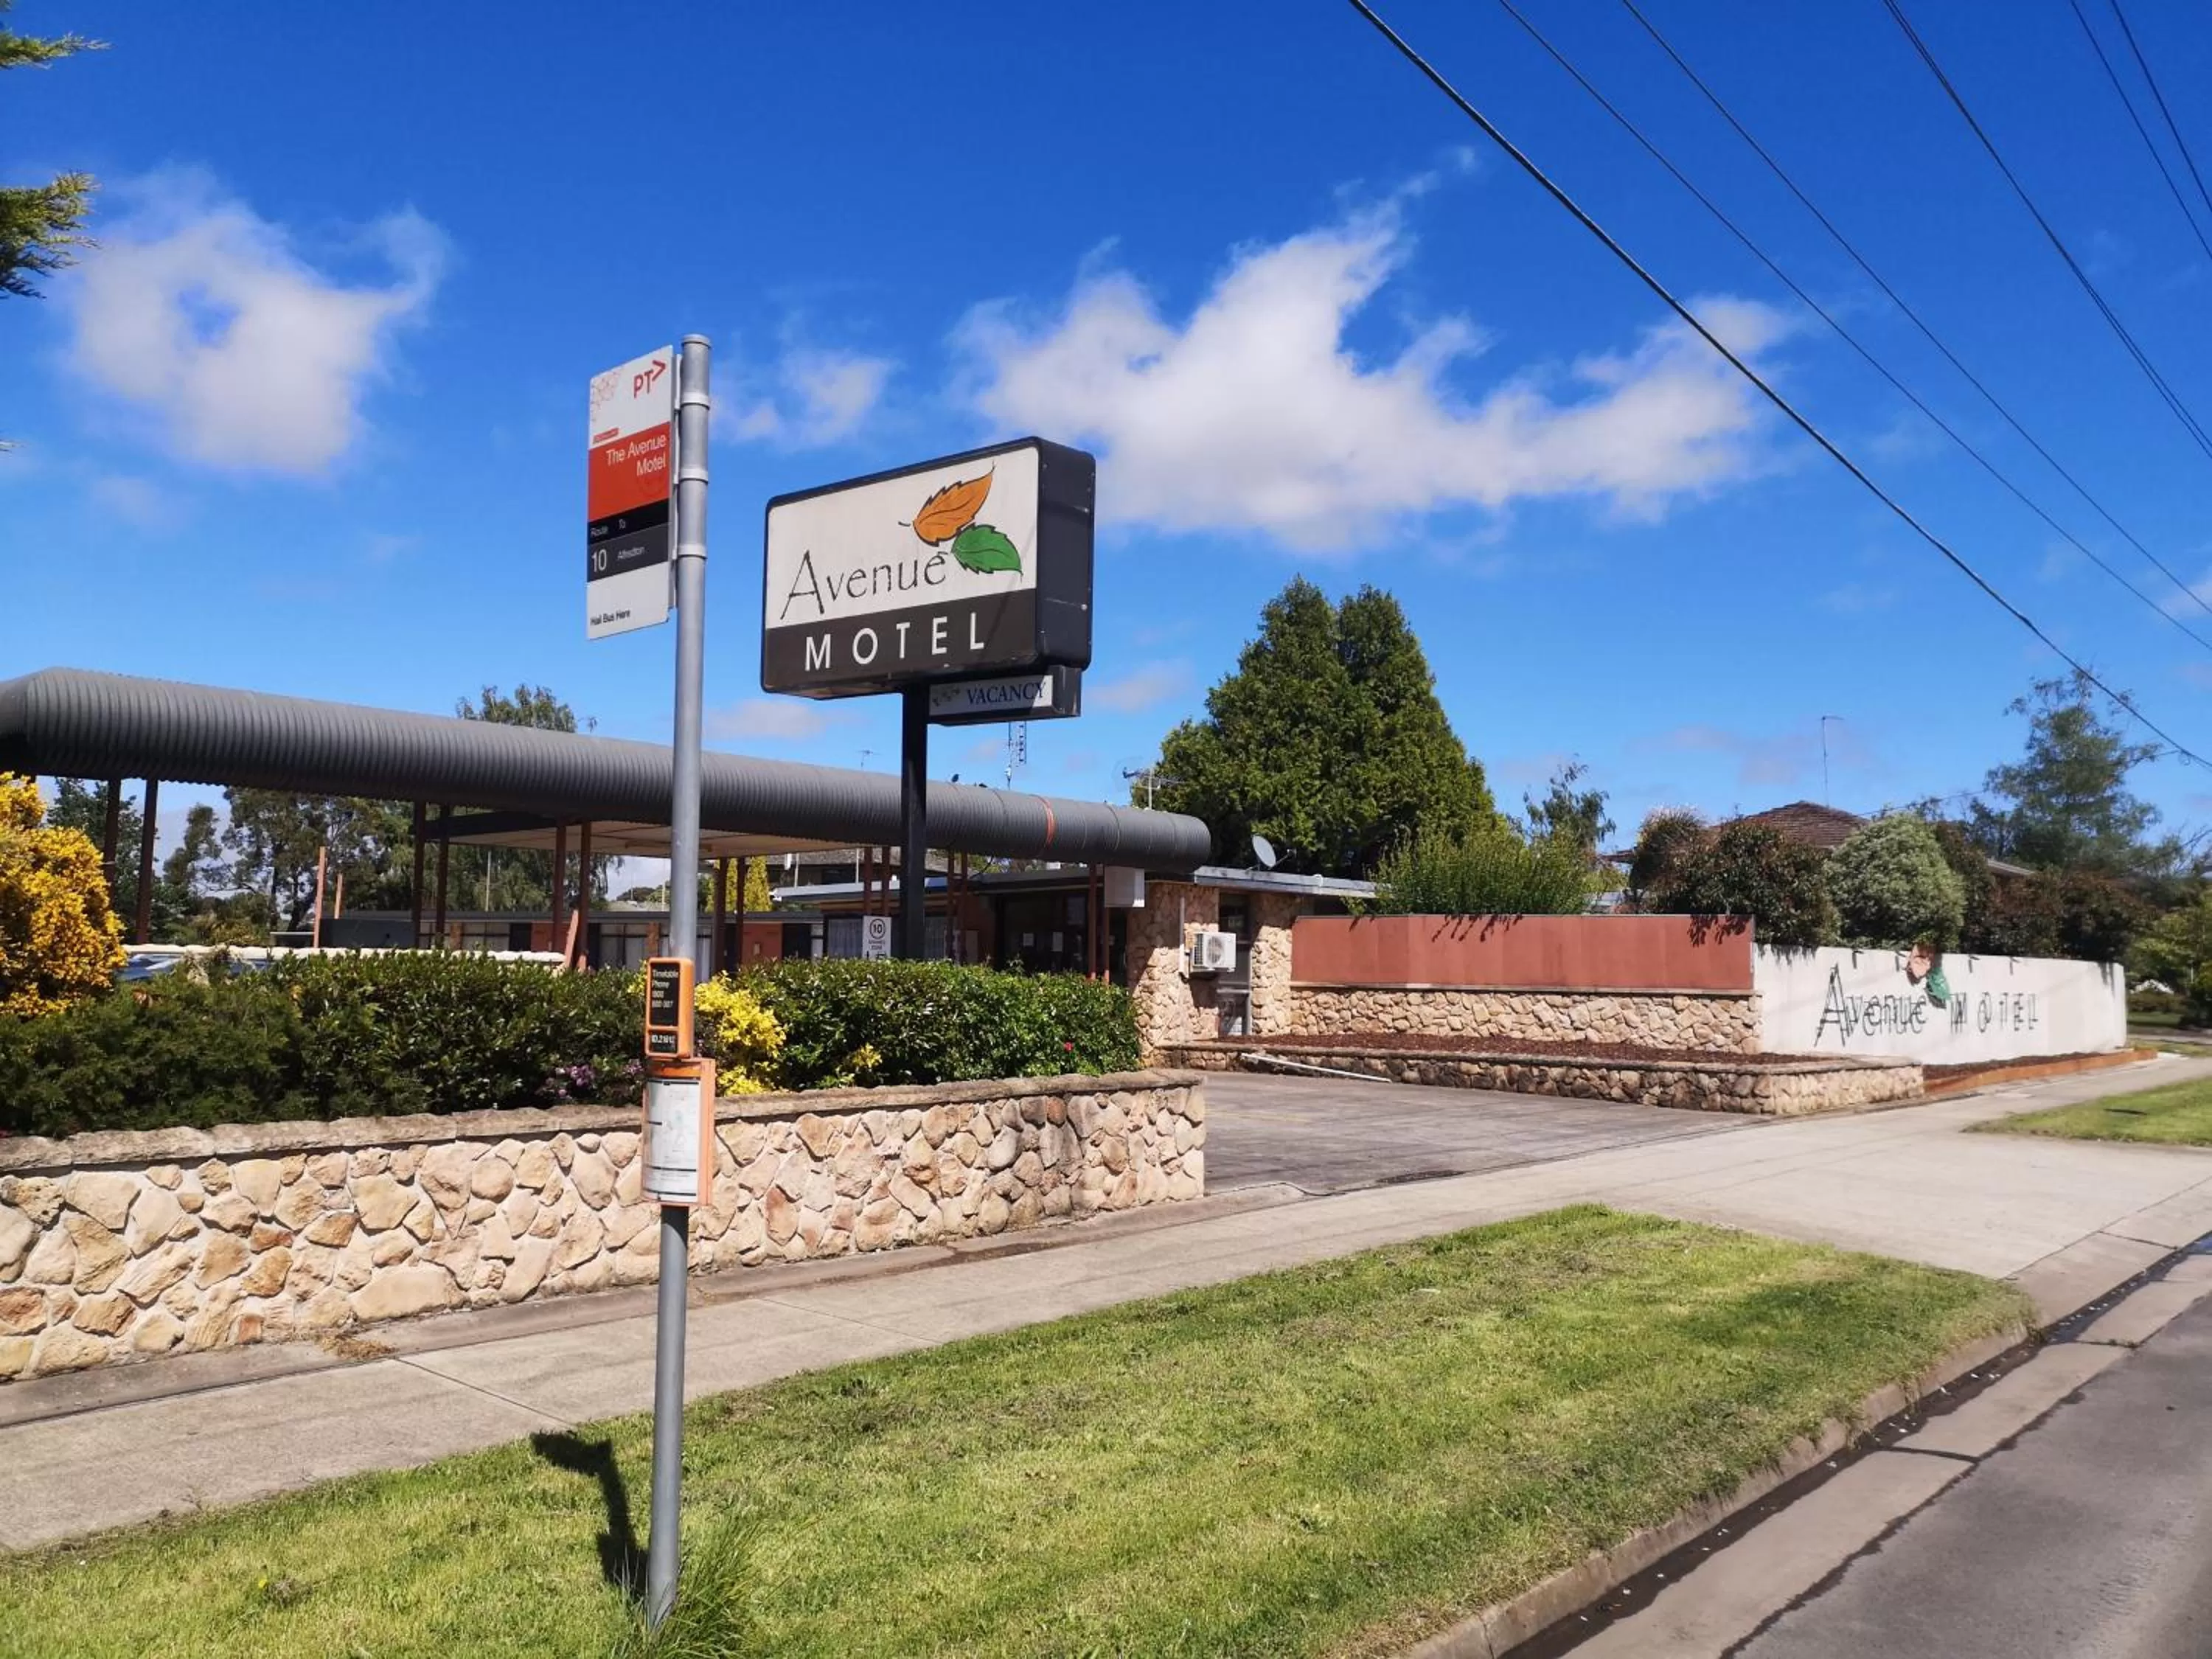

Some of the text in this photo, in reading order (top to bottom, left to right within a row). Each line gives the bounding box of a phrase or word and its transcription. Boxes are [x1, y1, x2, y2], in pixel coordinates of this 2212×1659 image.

[605, 448, 626, 467] The
[627, 434, 667, 459] Avenue
[636, 451, 666, 477] Motel
[591, 549, 607, 573] 10
[780, 549, 948, 620] Avenue
[603, 613, 614, 623] Bus
[616, 610, 630, 621] Here
[804, 612, 984, 672] MOTEL
[967, 681, 1046, 704] VACANCY
[873, 924, 883, 933] 10
[652, 969, 678, 978] Timetable
[652, 979, 669, 989] Phone
[1814, 963, 2038, 1047] Avenue MOTEL
